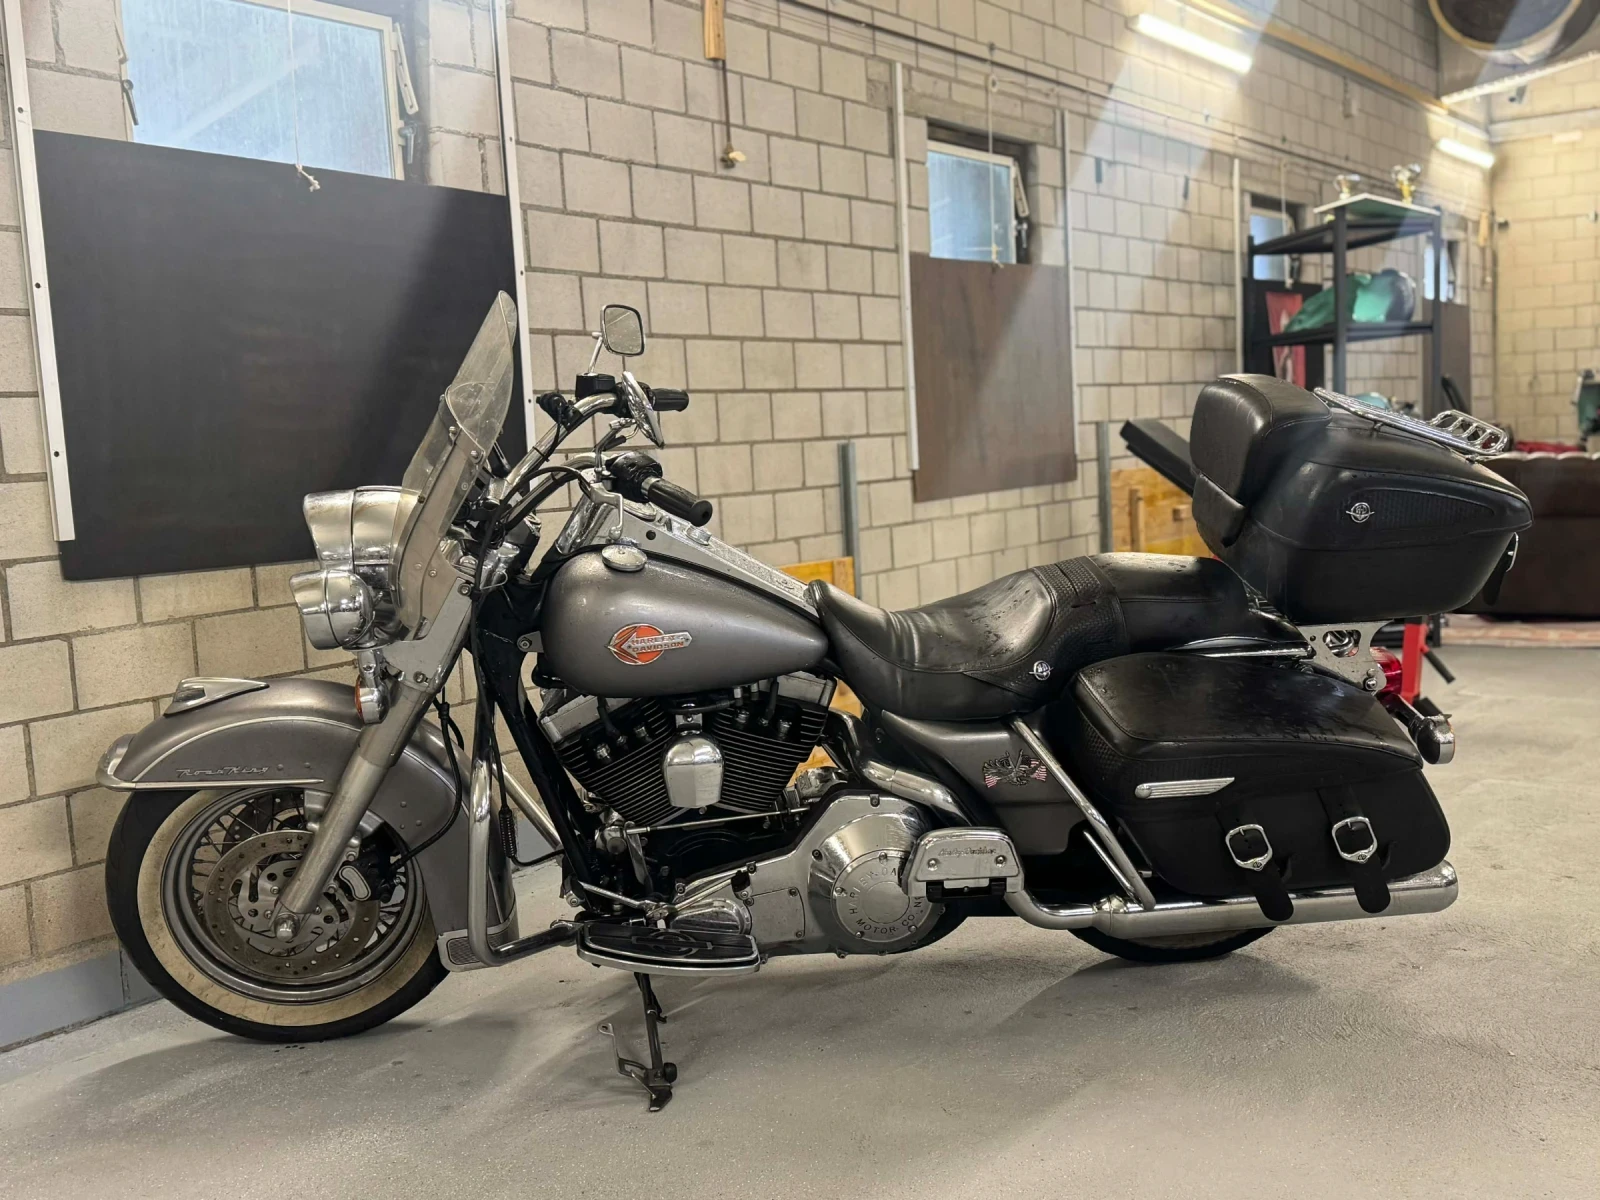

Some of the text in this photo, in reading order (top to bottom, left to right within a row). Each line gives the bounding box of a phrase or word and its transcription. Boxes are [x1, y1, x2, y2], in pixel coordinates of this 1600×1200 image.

[631, 634, 676, 646] HARLEY
[631, 641, 684, 653] DAVIDSON
[855, 918, 898, 935] MOTOR
